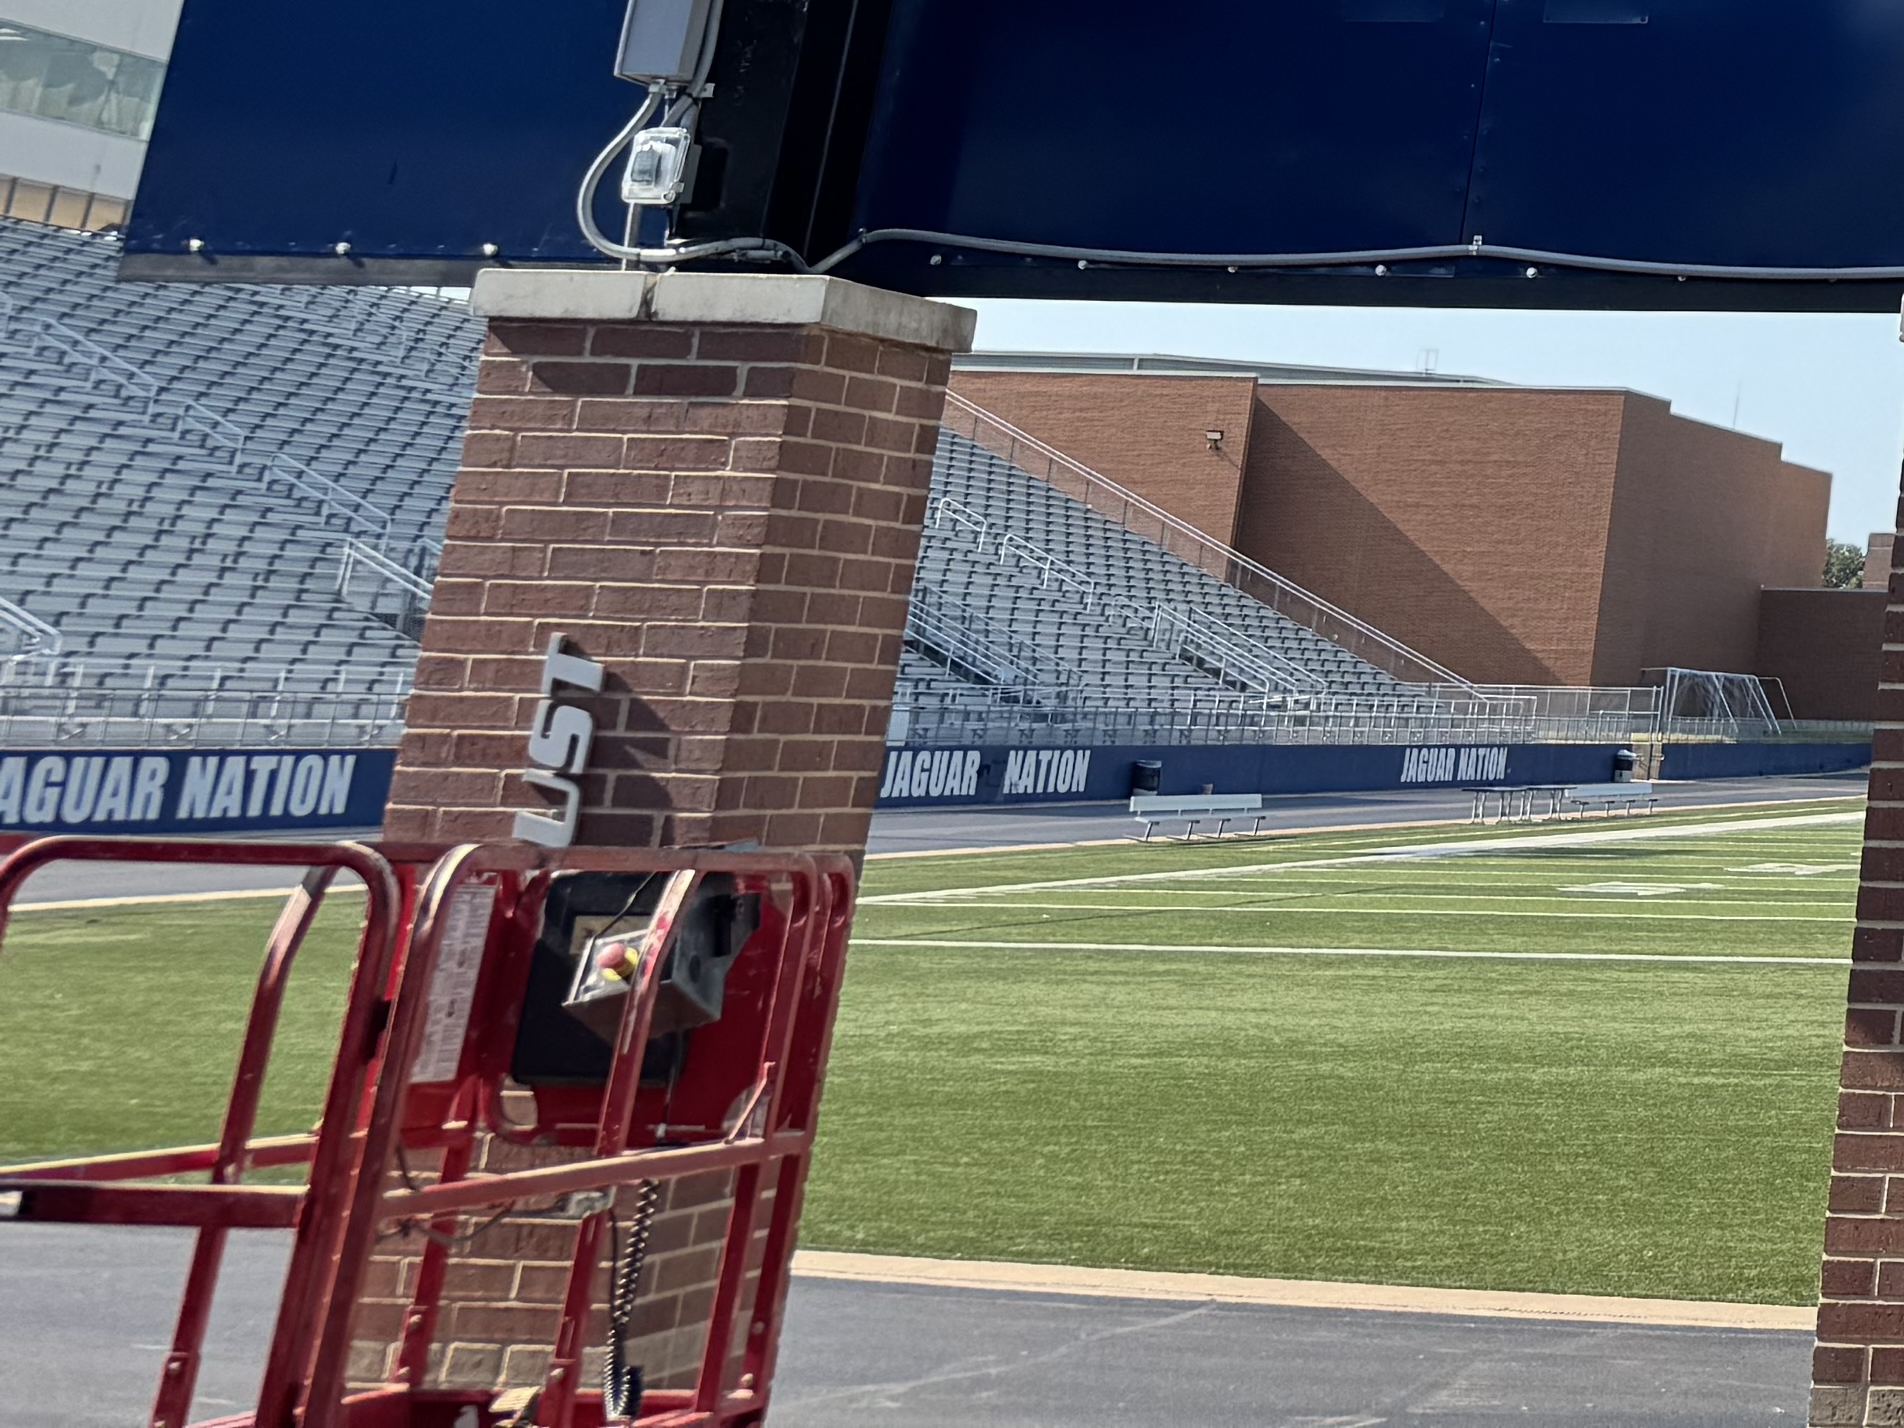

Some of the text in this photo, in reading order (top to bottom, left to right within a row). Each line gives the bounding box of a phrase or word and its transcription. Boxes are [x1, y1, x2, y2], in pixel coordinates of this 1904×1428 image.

[511, 631, 605, 848] UST
[1400, 747, 1508, 783] JAGUAR NATION
[176, 755, 357, 819] NATION
[880, 750, 1091, 798] JAGUAR NATION
